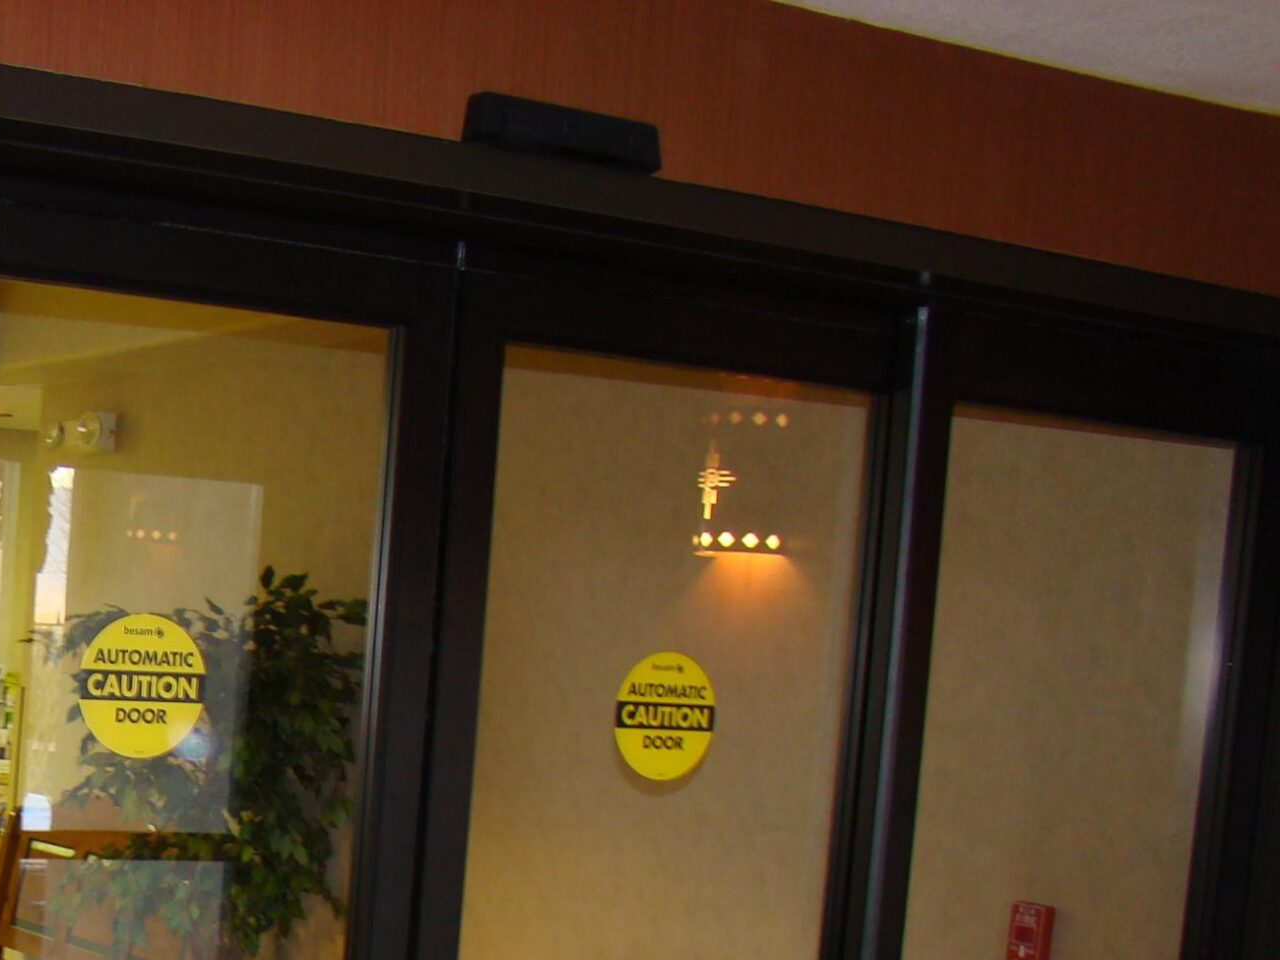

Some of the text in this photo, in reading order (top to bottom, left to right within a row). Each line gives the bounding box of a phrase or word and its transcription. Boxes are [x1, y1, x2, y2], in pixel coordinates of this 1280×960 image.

[123, 625, 153, 637] besam
[93, 647, 194, 668] AUTOMATIC
[87, 673, 198, 700] CAUTION
[627, 682, 707, 700] AUTOMATIC
[114, 707, 168, 725] DOOR
[621, 704, 710, 729] CAUTION
[642, 735, 684, 750] DOOR
